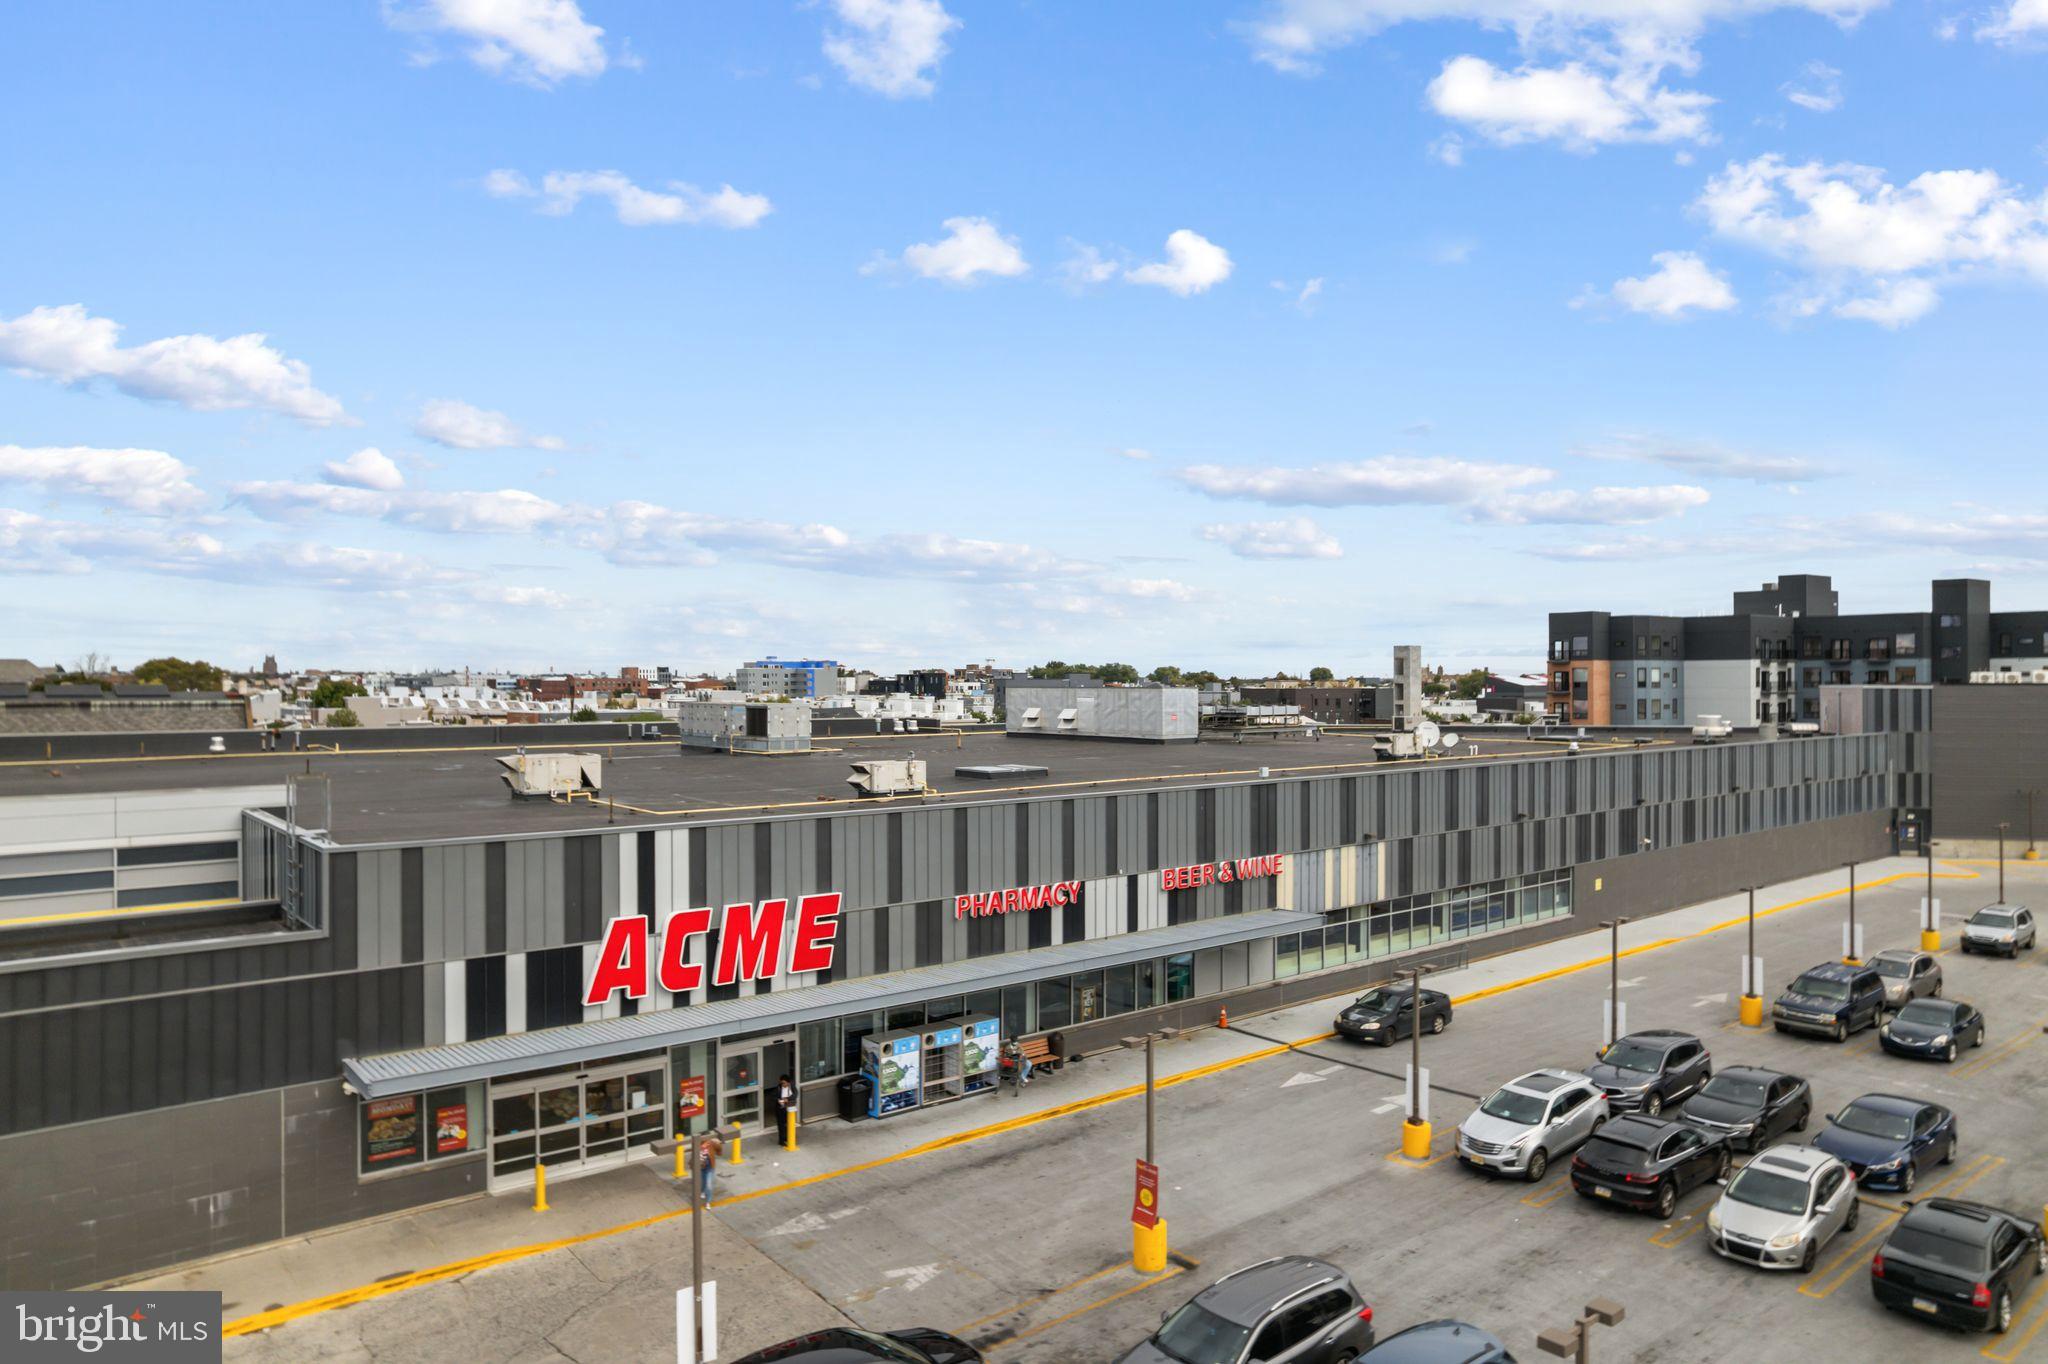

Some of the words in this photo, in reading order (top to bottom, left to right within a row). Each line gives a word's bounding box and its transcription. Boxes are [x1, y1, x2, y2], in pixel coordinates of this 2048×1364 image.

[1161, 862, 1214, 891] BEER
[1217, 860, 1233, 883] &
[1235, 854, 1284, 880] WINE
[955, 880, 1082, 920] PHARMACY
[582, 892, 842, 1006] ACME
